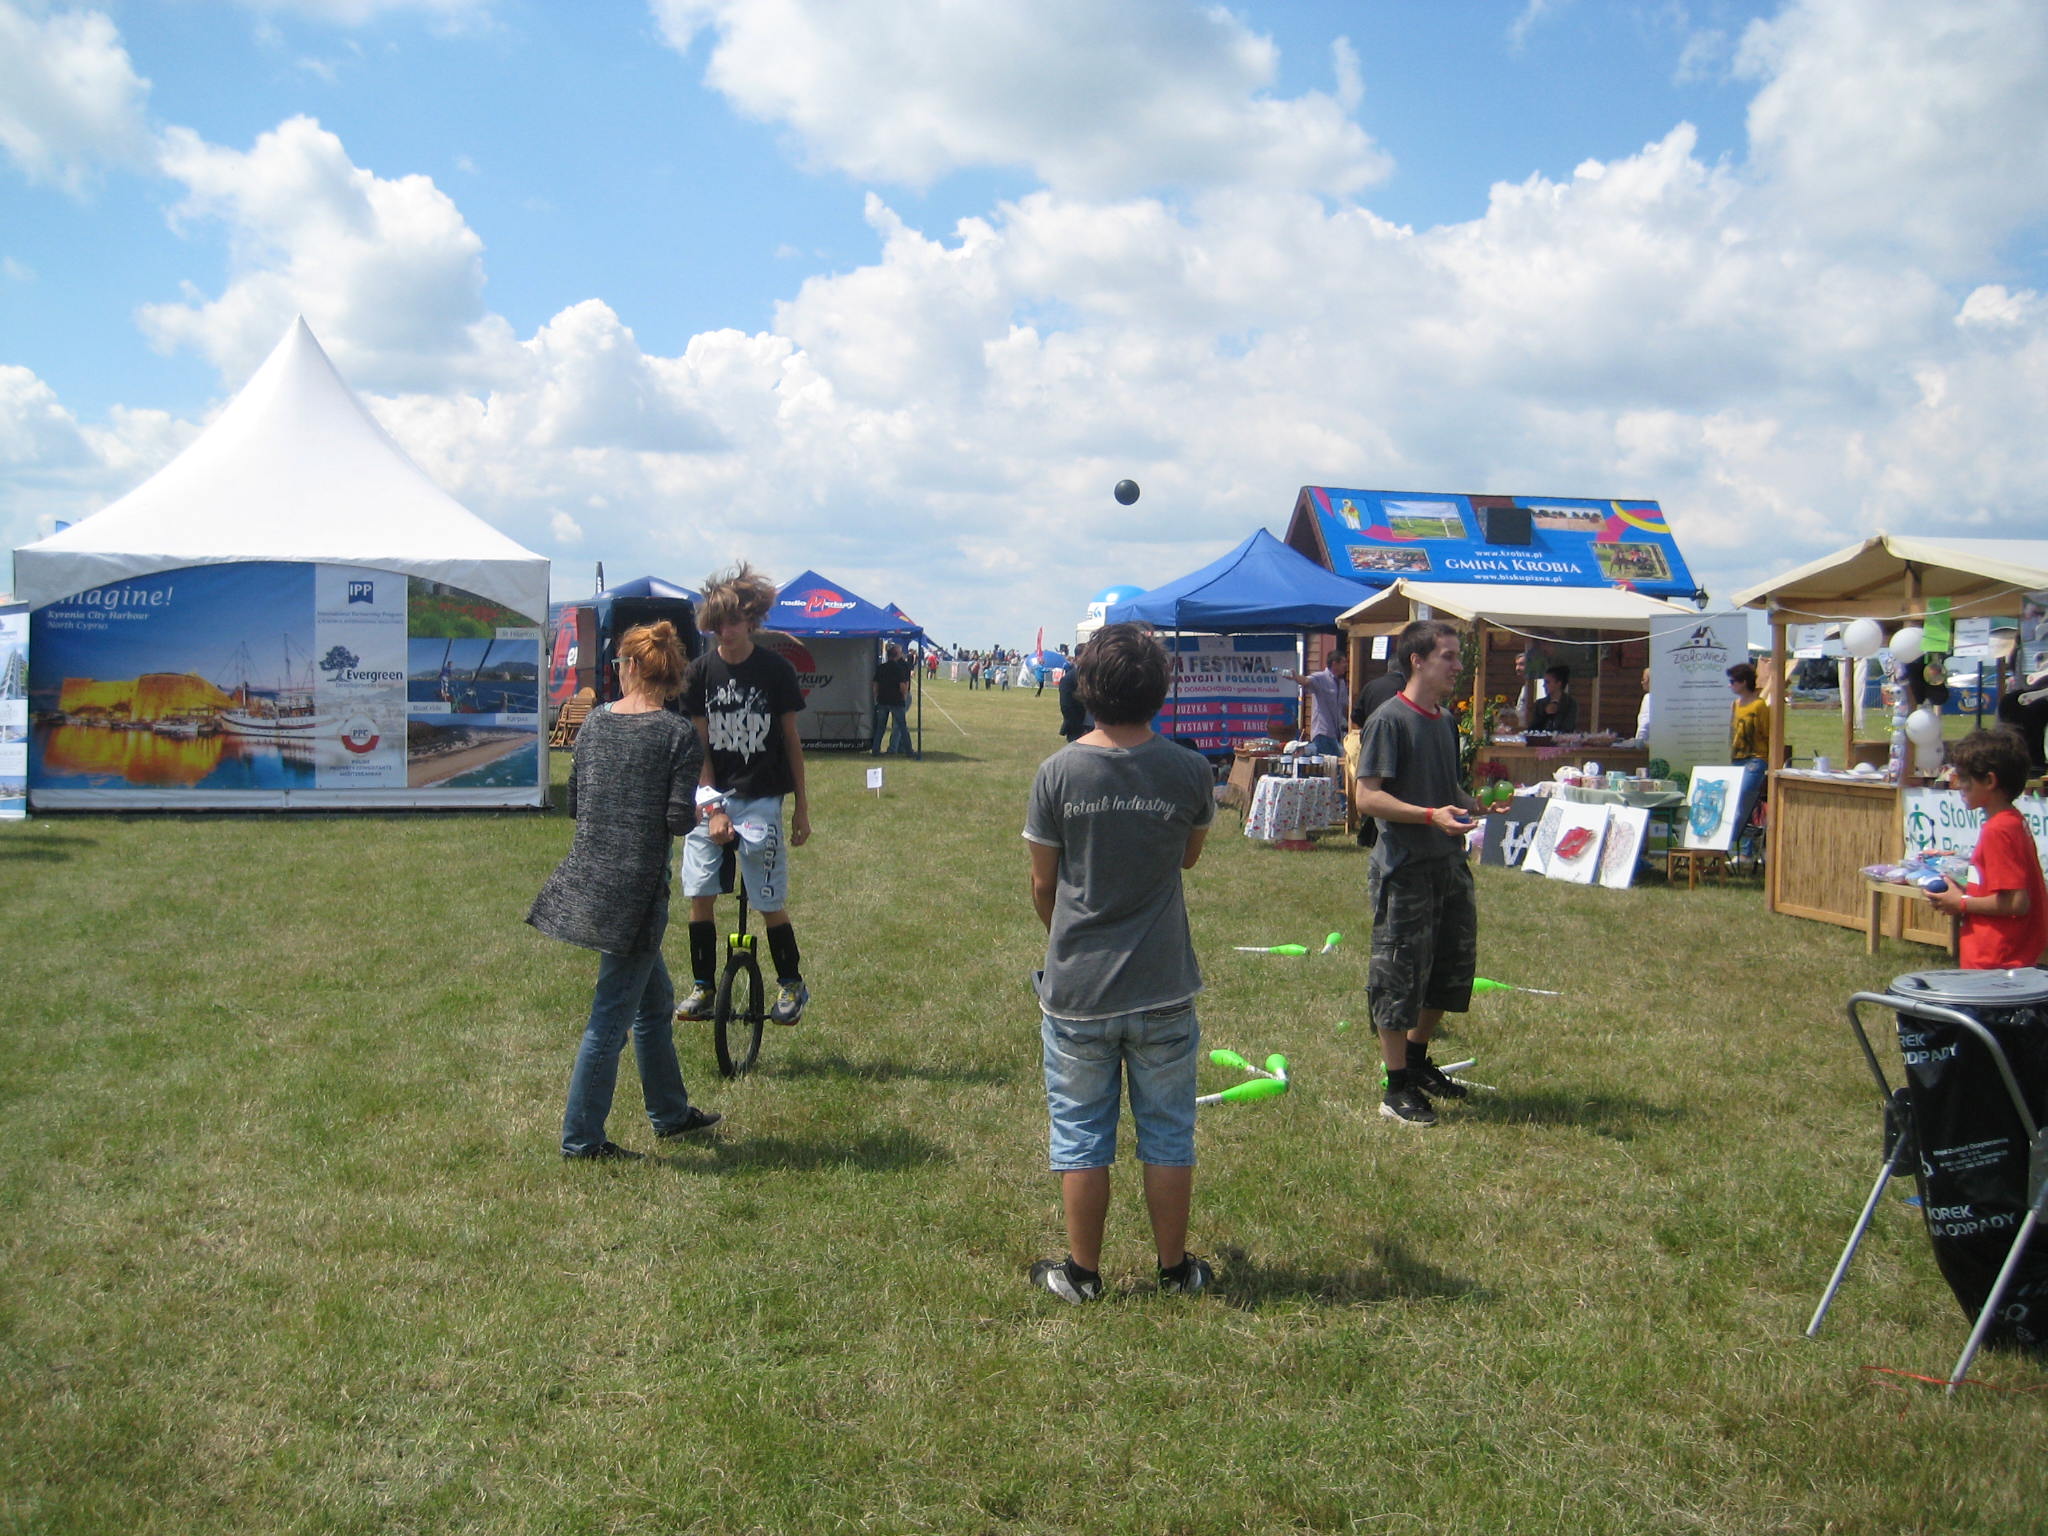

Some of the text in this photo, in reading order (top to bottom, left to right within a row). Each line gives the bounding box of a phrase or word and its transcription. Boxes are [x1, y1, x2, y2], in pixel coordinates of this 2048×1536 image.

[1475, 550, 1543, 559] www.krobia.pl
[1445, 558, 1583, 574] GMINA KROBIA
[1473, 574, 1562, 583] www.biskupizna.pl
[349, 584, 372, 597] IPP
[60, 585, 174, 610] magine!
[88, 611, 106, 620] City
[109, 611, 149, 620] Harbour
[47, 622, 74, 630] North
[1189, 655, 1273, 673] FESTIWAL
[347, 669, 403, 683] Evergreen
[1171, 674, 1214, 683] RADYCJI
[1063, 794, 1177, 822] Retail Industry
